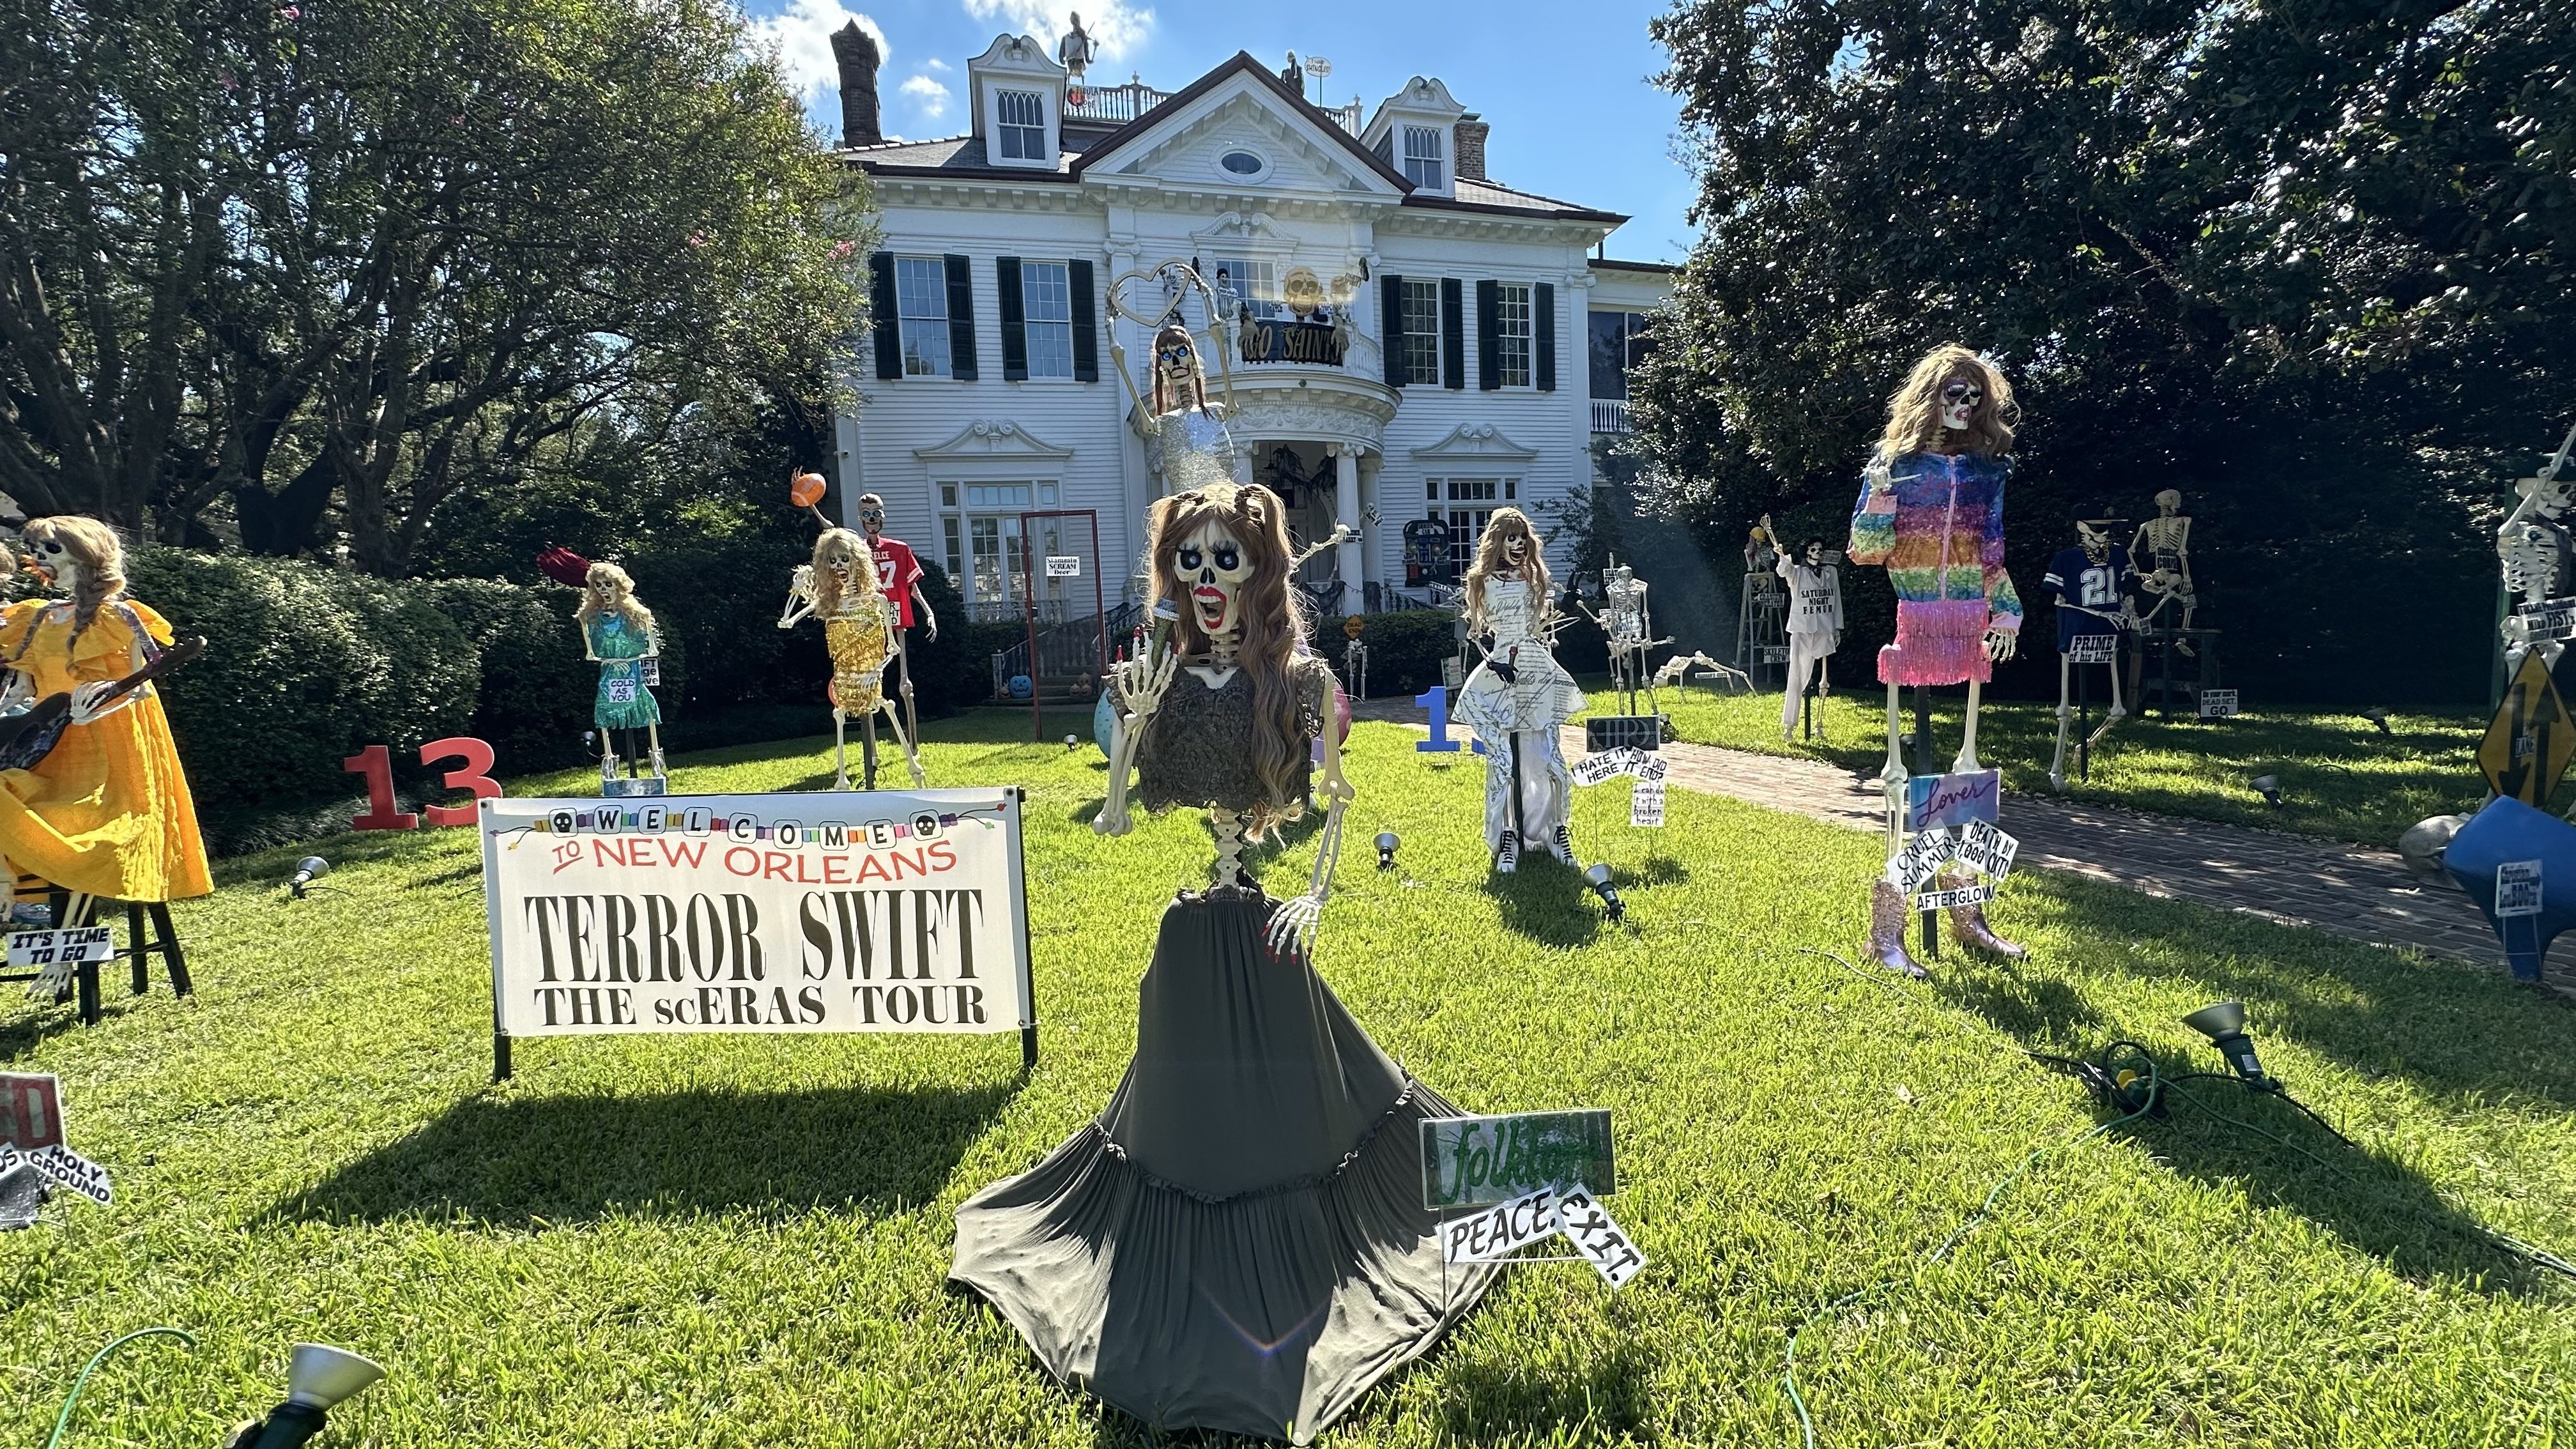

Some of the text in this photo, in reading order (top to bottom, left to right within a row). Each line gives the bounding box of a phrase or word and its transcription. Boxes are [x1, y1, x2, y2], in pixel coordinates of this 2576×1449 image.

[1801, 588, 1834, 598] SATURDAY
[2080, 566, 2118, 606] 21
[1803, 604, 1832, 614] FEMUR
[1809, 597, 1829, 606] NIGHT
[1764, 648, 1790, 656] SKELETO
[2073, 636, 2113, 651] PRIME
[2069, 650, 2113, 662] of his LIFE
[2211, 705, 2228, 716] GO
[1571, 747, 1625, 777] I HATE IT
[1630, 748, 1667, 771] HOW DID
[1588, 763, 1619, 783] HERE
[1625, 760, 1664, 783] IT END?
[344, 737, 503, 830] 13
[1656, 784, 1664, 793] do
[1634, 805, 1662, 815] broken
[1641, 795, 1658, 805] with
[1915, 778, 1998, 827] Lover
[597, 808, 888, 848] WELCOME
[1636, 815, 1660, 826] heart
[1970, 820, 2014, 856] DEATH BY
[552, 838, 957, 884] TO NEW ORLEANS
[1897, 831, 1944, 870] CRUEL
[1901, 836, 1956, 895] SUMMER
[1986, 852, 2009, 879] CUTS
[1916, 885, 1995, 910] AFTERGLOW
[12, 927, 110, 949] IT'S TIME
[523, 889, 984, 983] TERROR SWIFT
[31, 946, 88, 964] TO GO
[533, 985, 988, 1027] THE scERAS TOUR
[49, 1145, 103, 1181] HOLY
[29, 1151, 111, 1202] GROUND
